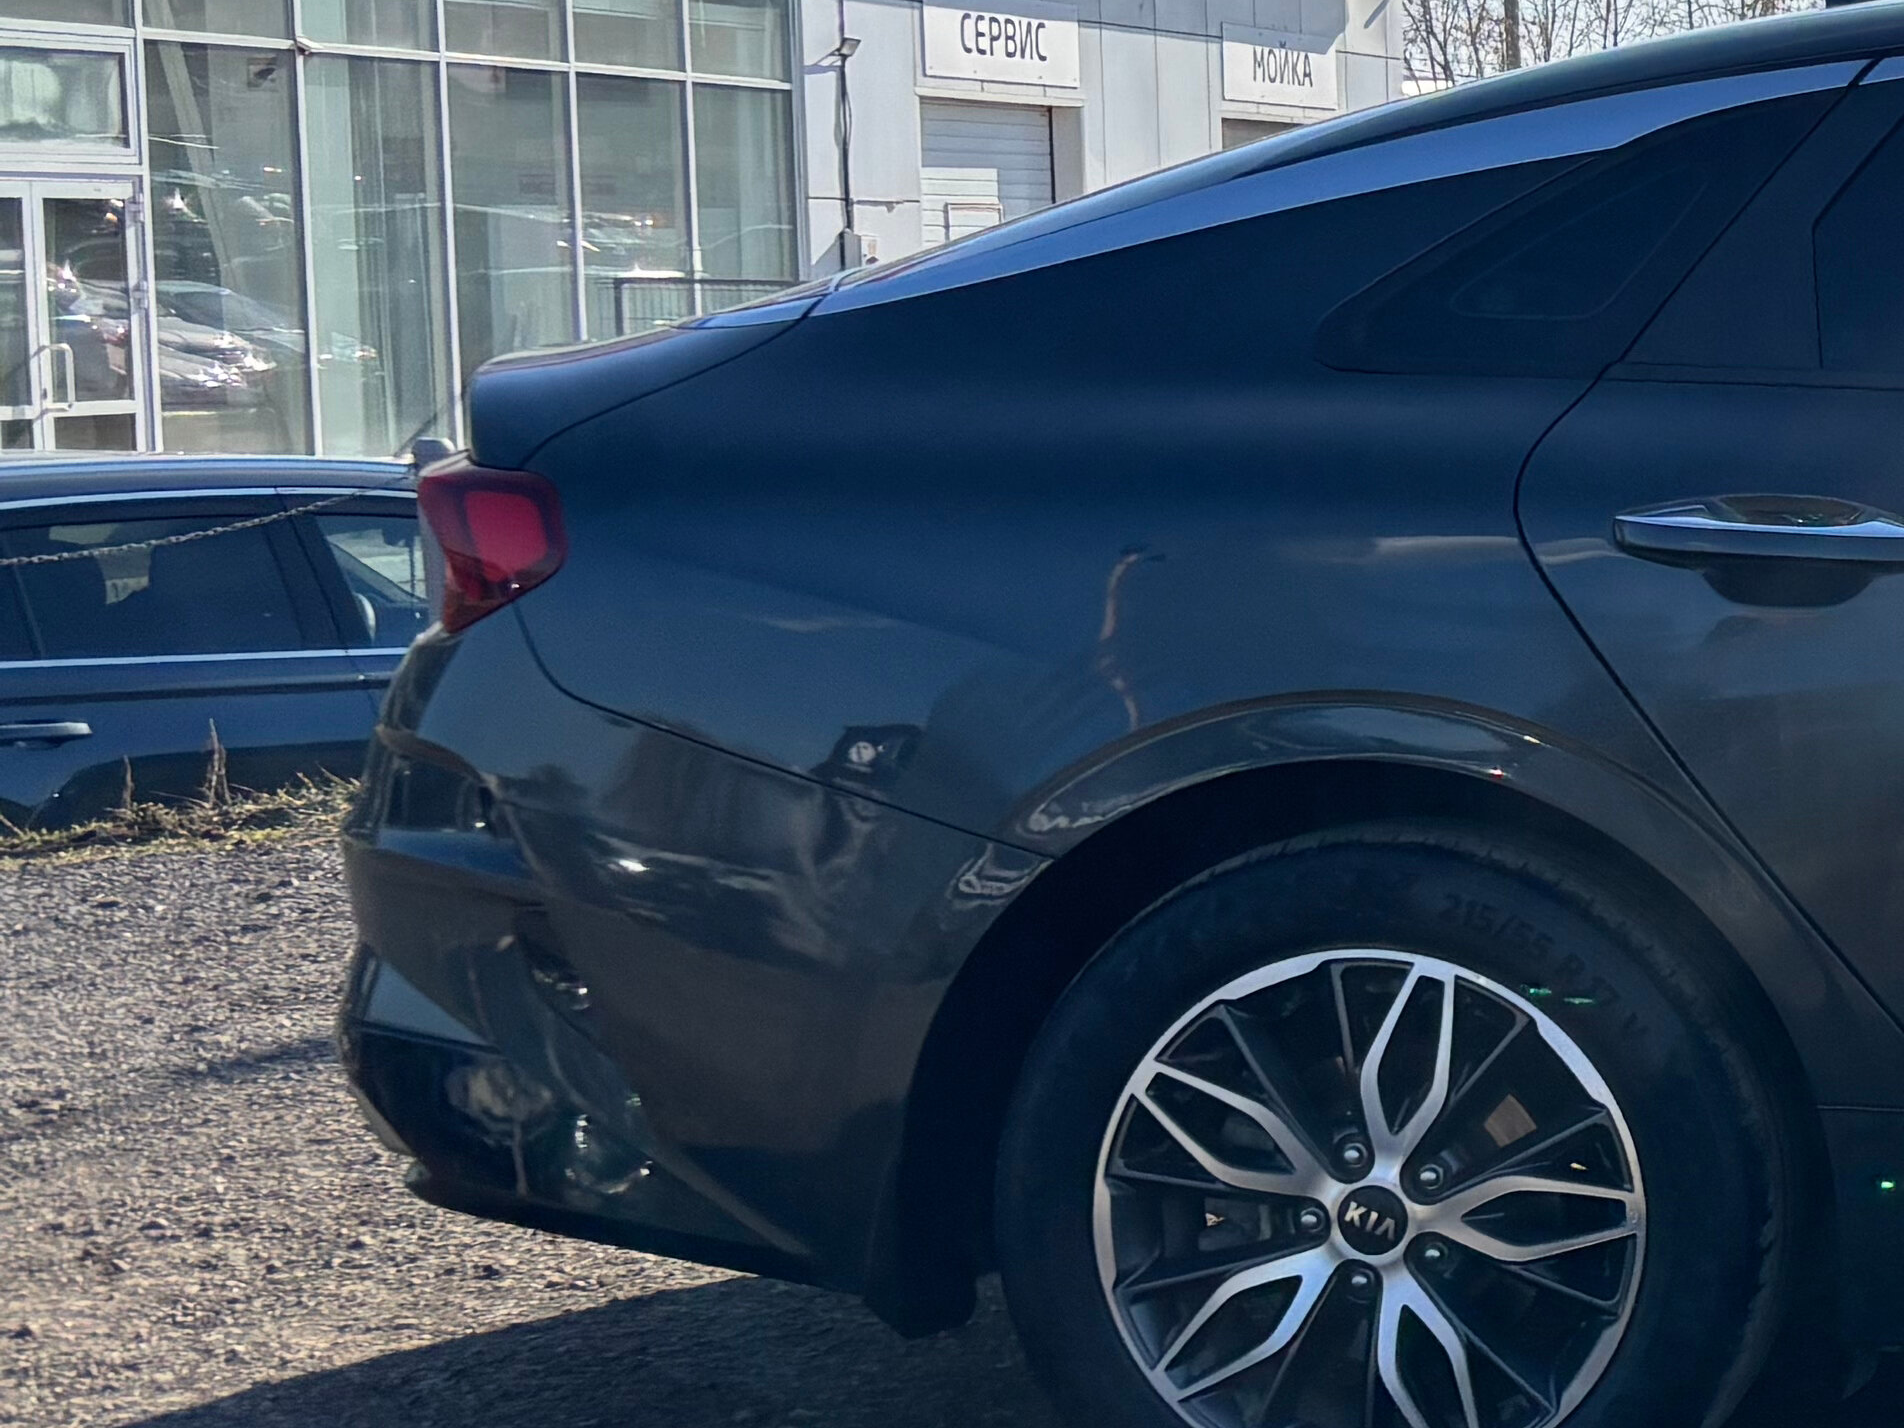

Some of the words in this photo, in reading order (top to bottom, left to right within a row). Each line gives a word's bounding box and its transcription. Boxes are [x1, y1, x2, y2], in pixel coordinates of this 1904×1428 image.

[959, 12, 1049, 63] СЕРВИС
[1252, 40, 1314, 88] МОЙКА
[1344, 1201, 1396, 1241] KIA
